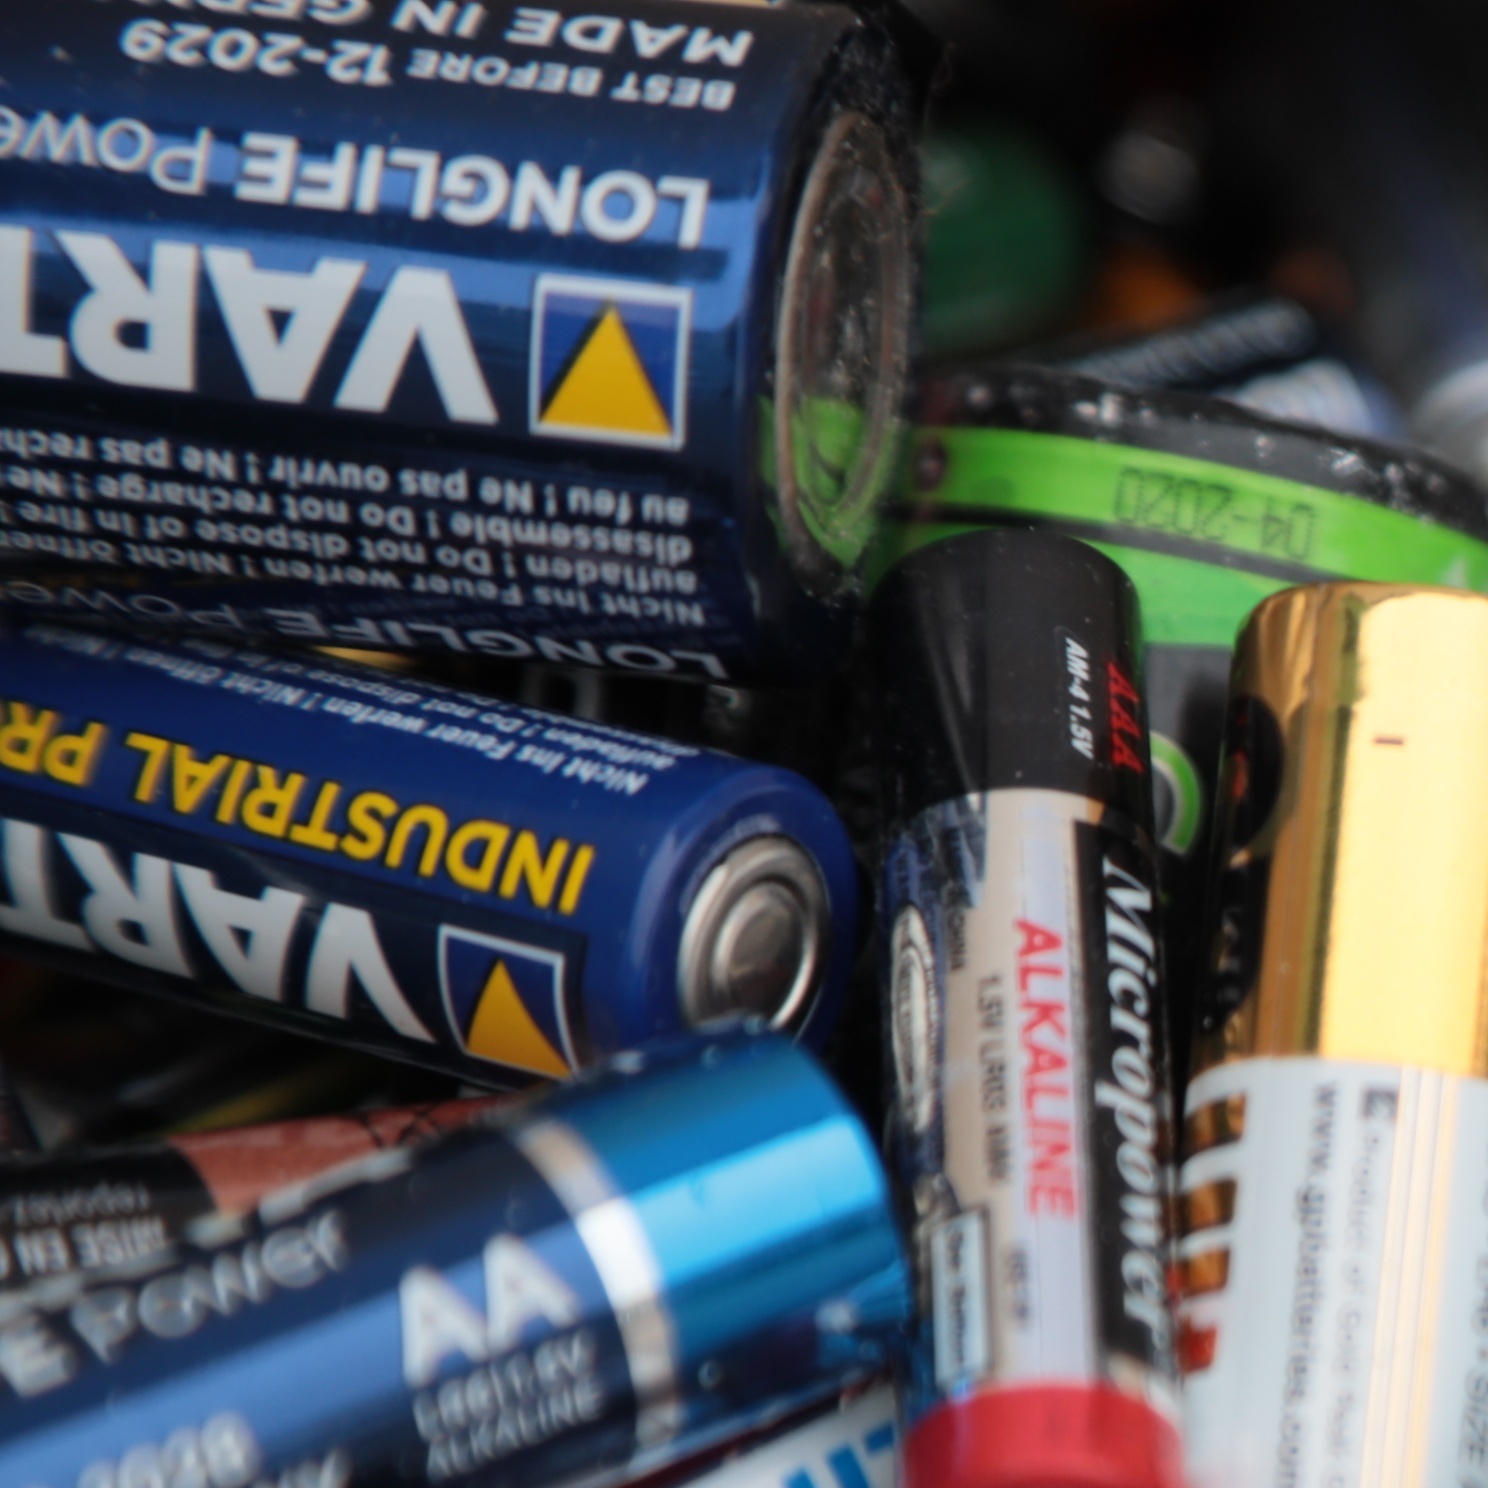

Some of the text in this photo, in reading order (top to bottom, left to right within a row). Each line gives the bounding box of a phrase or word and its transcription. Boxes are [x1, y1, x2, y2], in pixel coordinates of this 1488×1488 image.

[121, 11, 391, 89] 12-2029
[391, 0, 750, 73] MADE IN
[407, 45, 600, 99] BEFORE
[612, 68, 732, 112] BEST
[234, 131, 711, 249] LONGLIFE
[0, 223, 500, 425] VART
[95, 431, 165, 469] pas
[170, 444, 234, 480] Ne
[266, 452, 387, 497] ouvrir
[397, 460, 469, 500] pas
[474, 476, 533, 512] Ne
[564, 483, 630, 523] feu
[0, 462, 689, 569] disassemble Do not recharge Ne
[194, 510, 346, 560] dispose
[360, 534, 426, 568] not
[438, 544, 493, 576] Do
[527, 550, 694, 600] aufladen
[601, 590, 704, 627] Nicht
[278, 608, 723, 680] LONGLIFE
[327, 690, 424, 742] werfen
[1062, 637, 1095, 760] AM-4 1.5V
[1099, 658, 1146, 776] AAA
[427, 715, 505, 763] Feuer
[557, 745, 649, 803] Nicht
[125, 730, 597, 917] INDUSTRIAL
[0, 814, 438, 1047] VART
[998, 919, 1091, 1223] ALKALINE
[1094, 865, 1176, 1321] Micropower
[401, 1233, 580, 1386] AA
